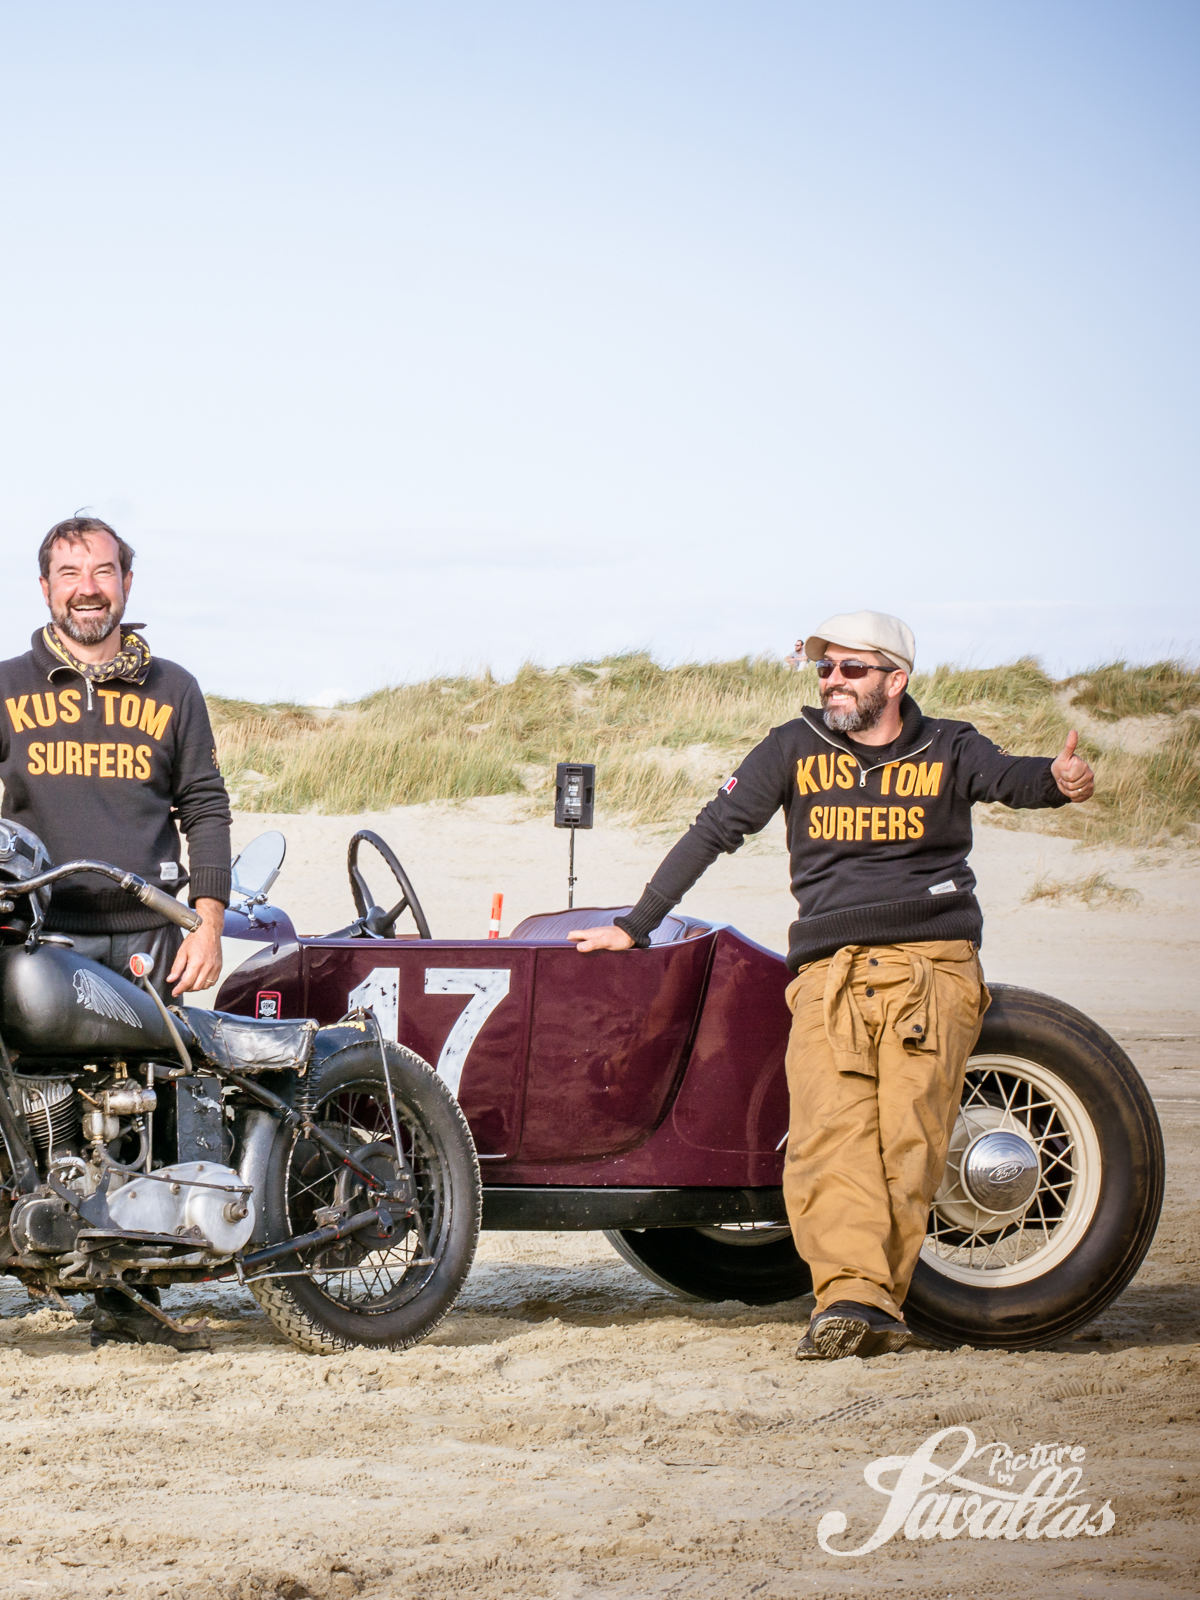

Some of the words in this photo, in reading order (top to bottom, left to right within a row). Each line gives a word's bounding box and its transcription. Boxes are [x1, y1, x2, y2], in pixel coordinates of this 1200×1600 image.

[27, 741, 152, 780] SURFERS
[808, 805, 925, 841] SURFERS
[348, 967, 512, 1101] 17
